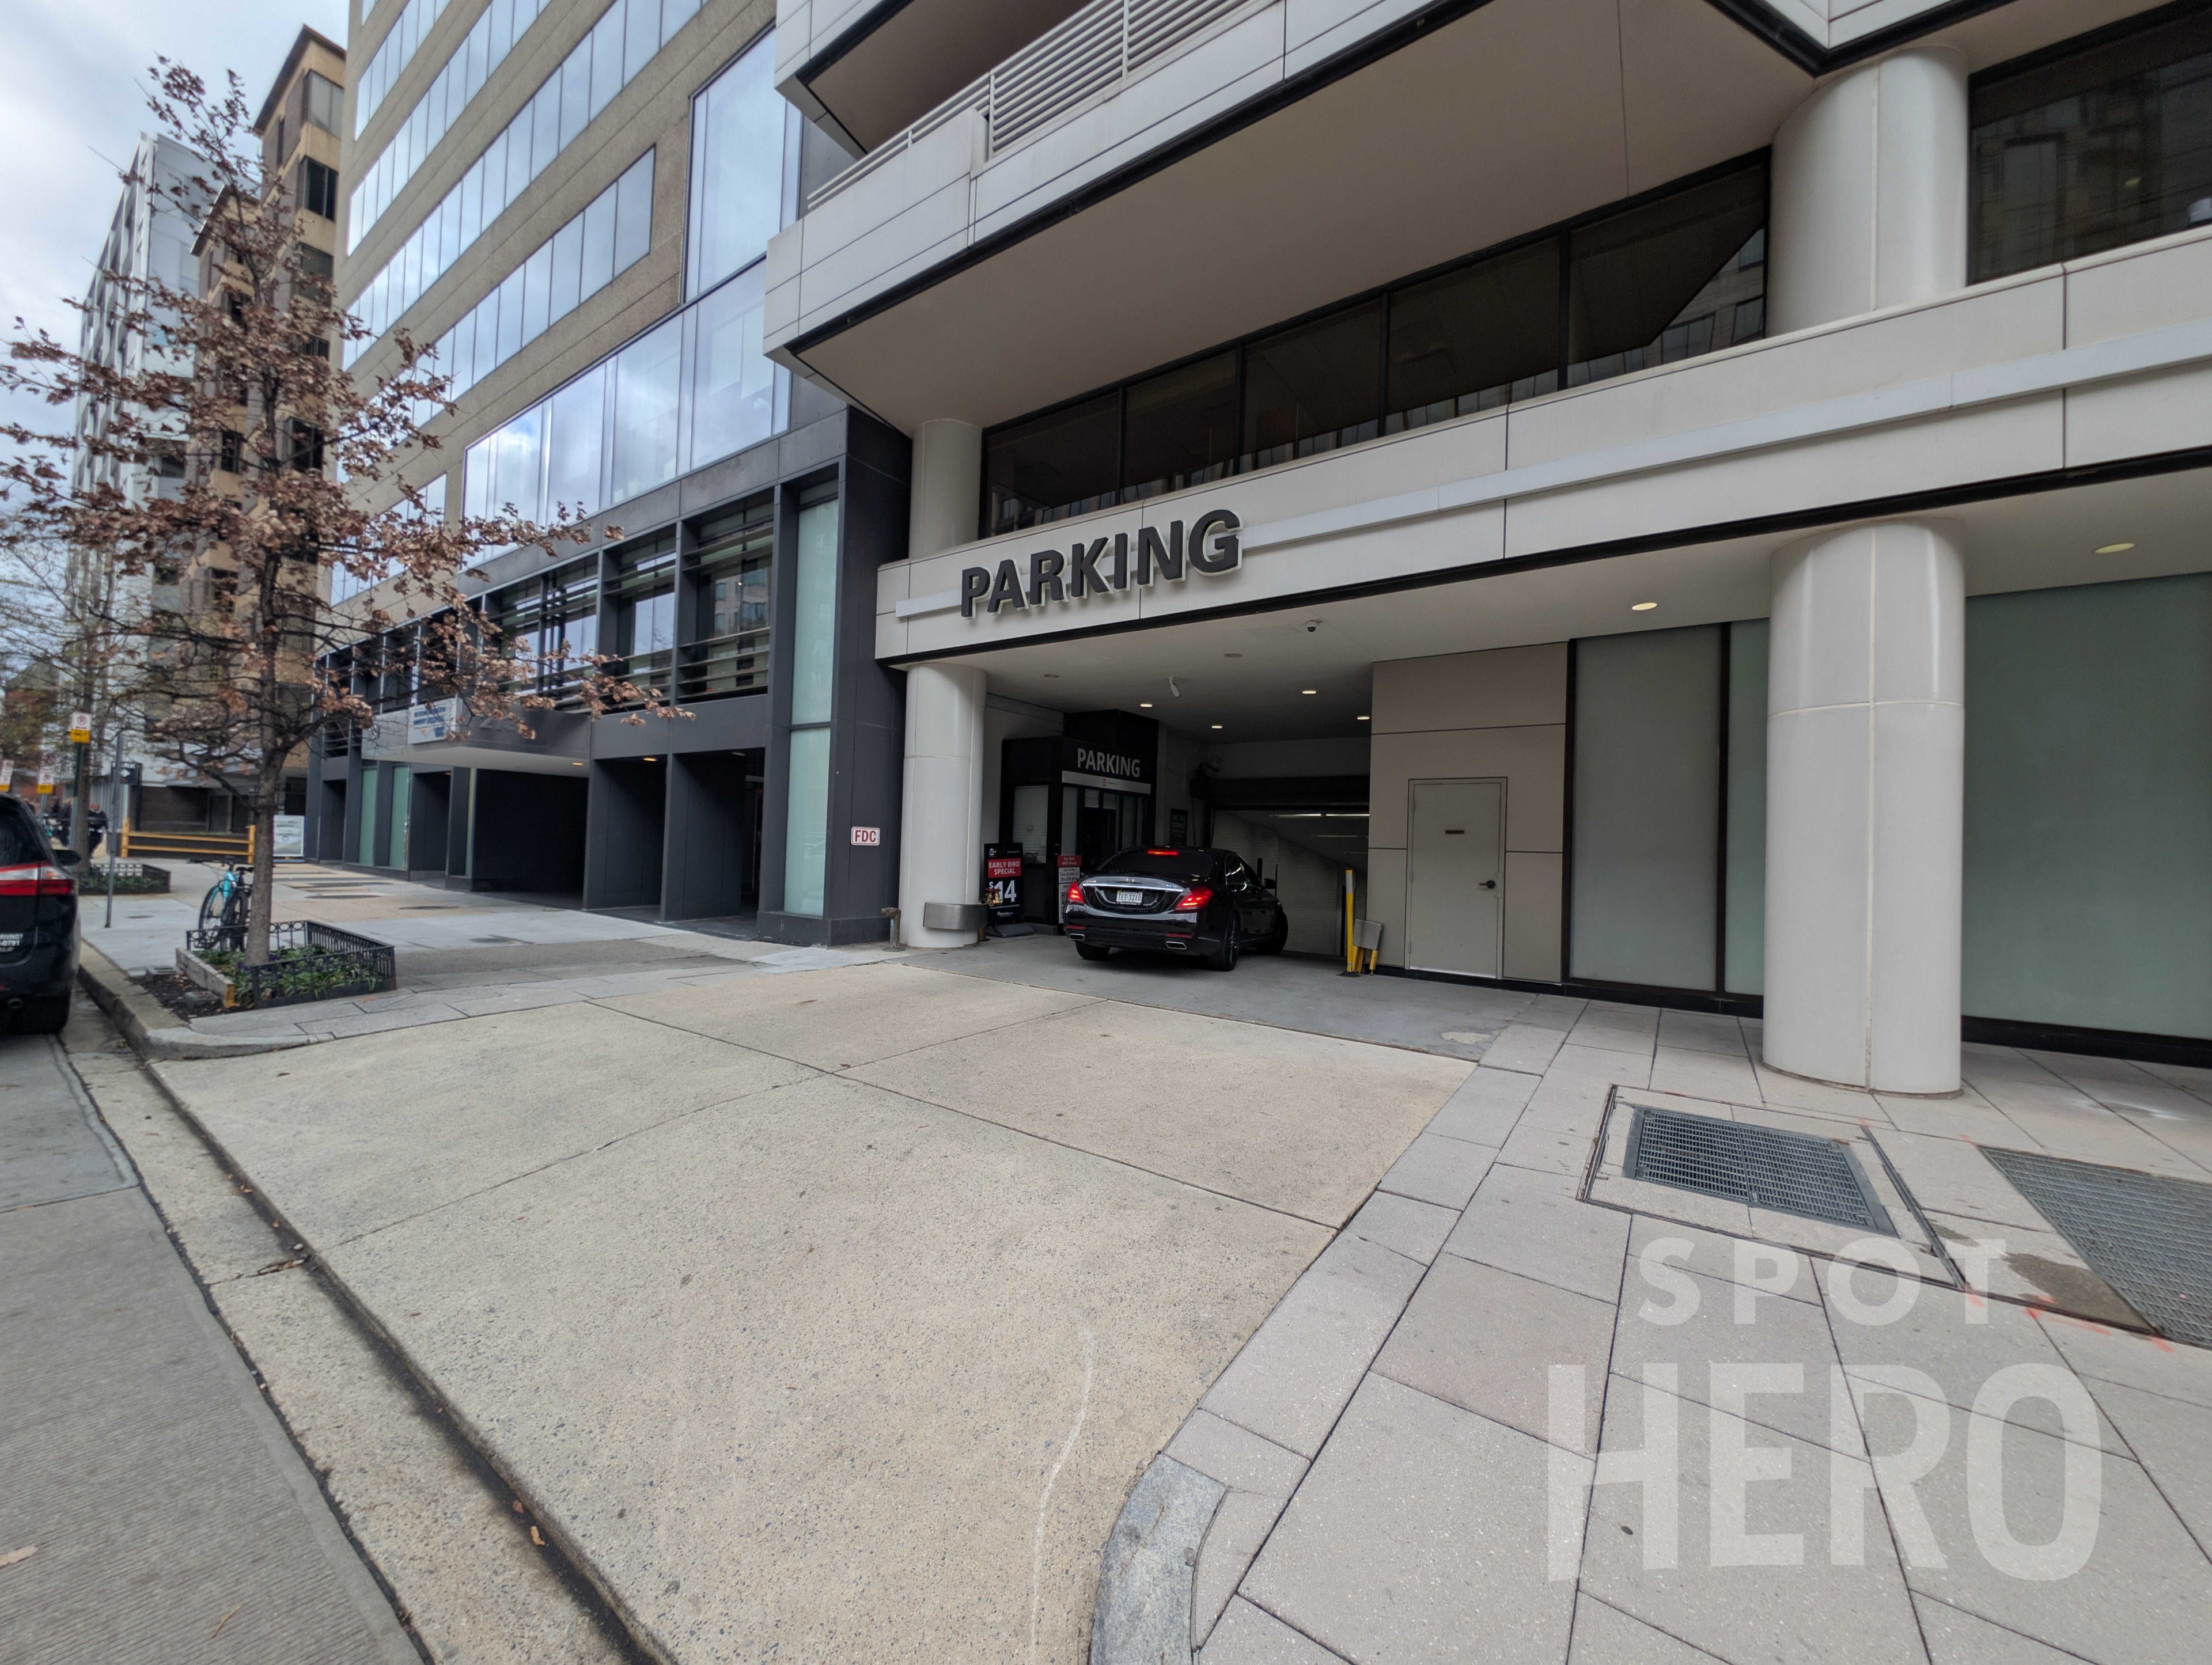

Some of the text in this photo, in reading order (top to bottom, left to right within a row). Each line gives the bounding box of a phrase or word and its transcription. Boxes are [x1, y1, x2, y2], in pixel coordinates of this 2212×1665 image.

[961, 509, 1244, 620] PARKING
[1077, 748, 1141, 778] PARKING
[855, 829, 877, 843] FDC
[1118, 893, 1141, 901] TET-3210
